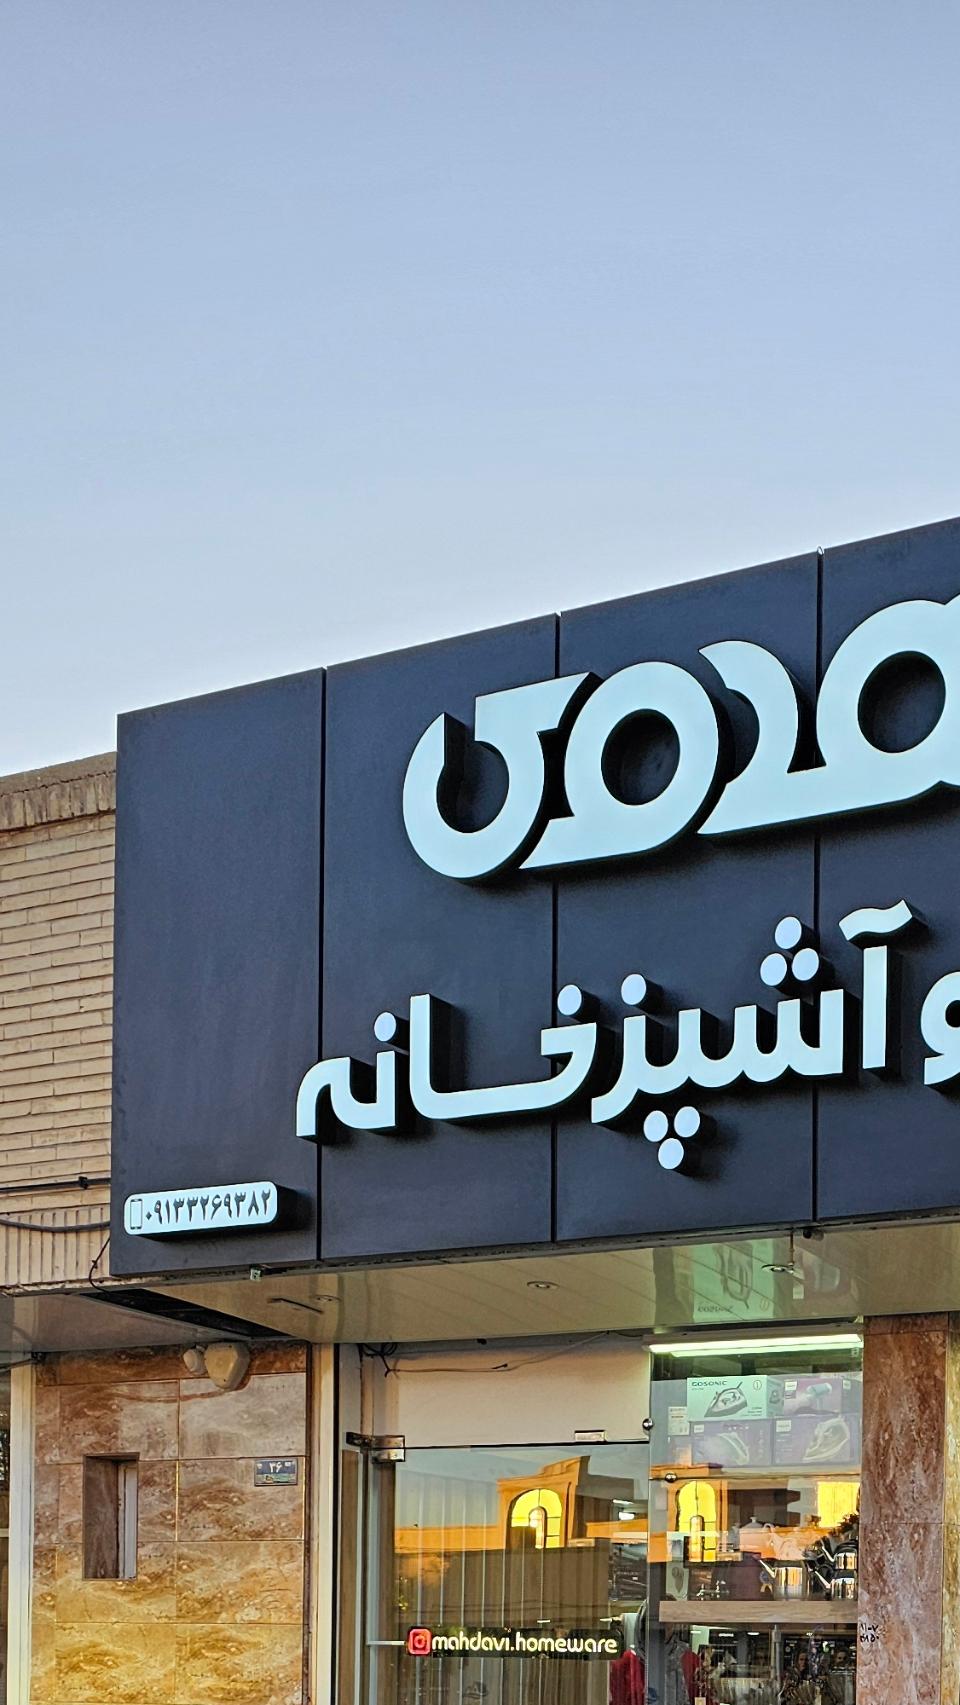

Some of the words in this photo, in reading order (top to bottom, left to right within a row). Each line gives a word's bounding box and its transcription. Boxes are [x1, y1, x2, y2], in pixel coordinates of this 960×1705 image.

[296, 899, 913, 1170] آشپزخانه
[145, 1189, 271, 1225] ۰۹۱۳۳۲۶۹۳۸۲
[432, 1631, 618, 1653] mahdavi.homeware
